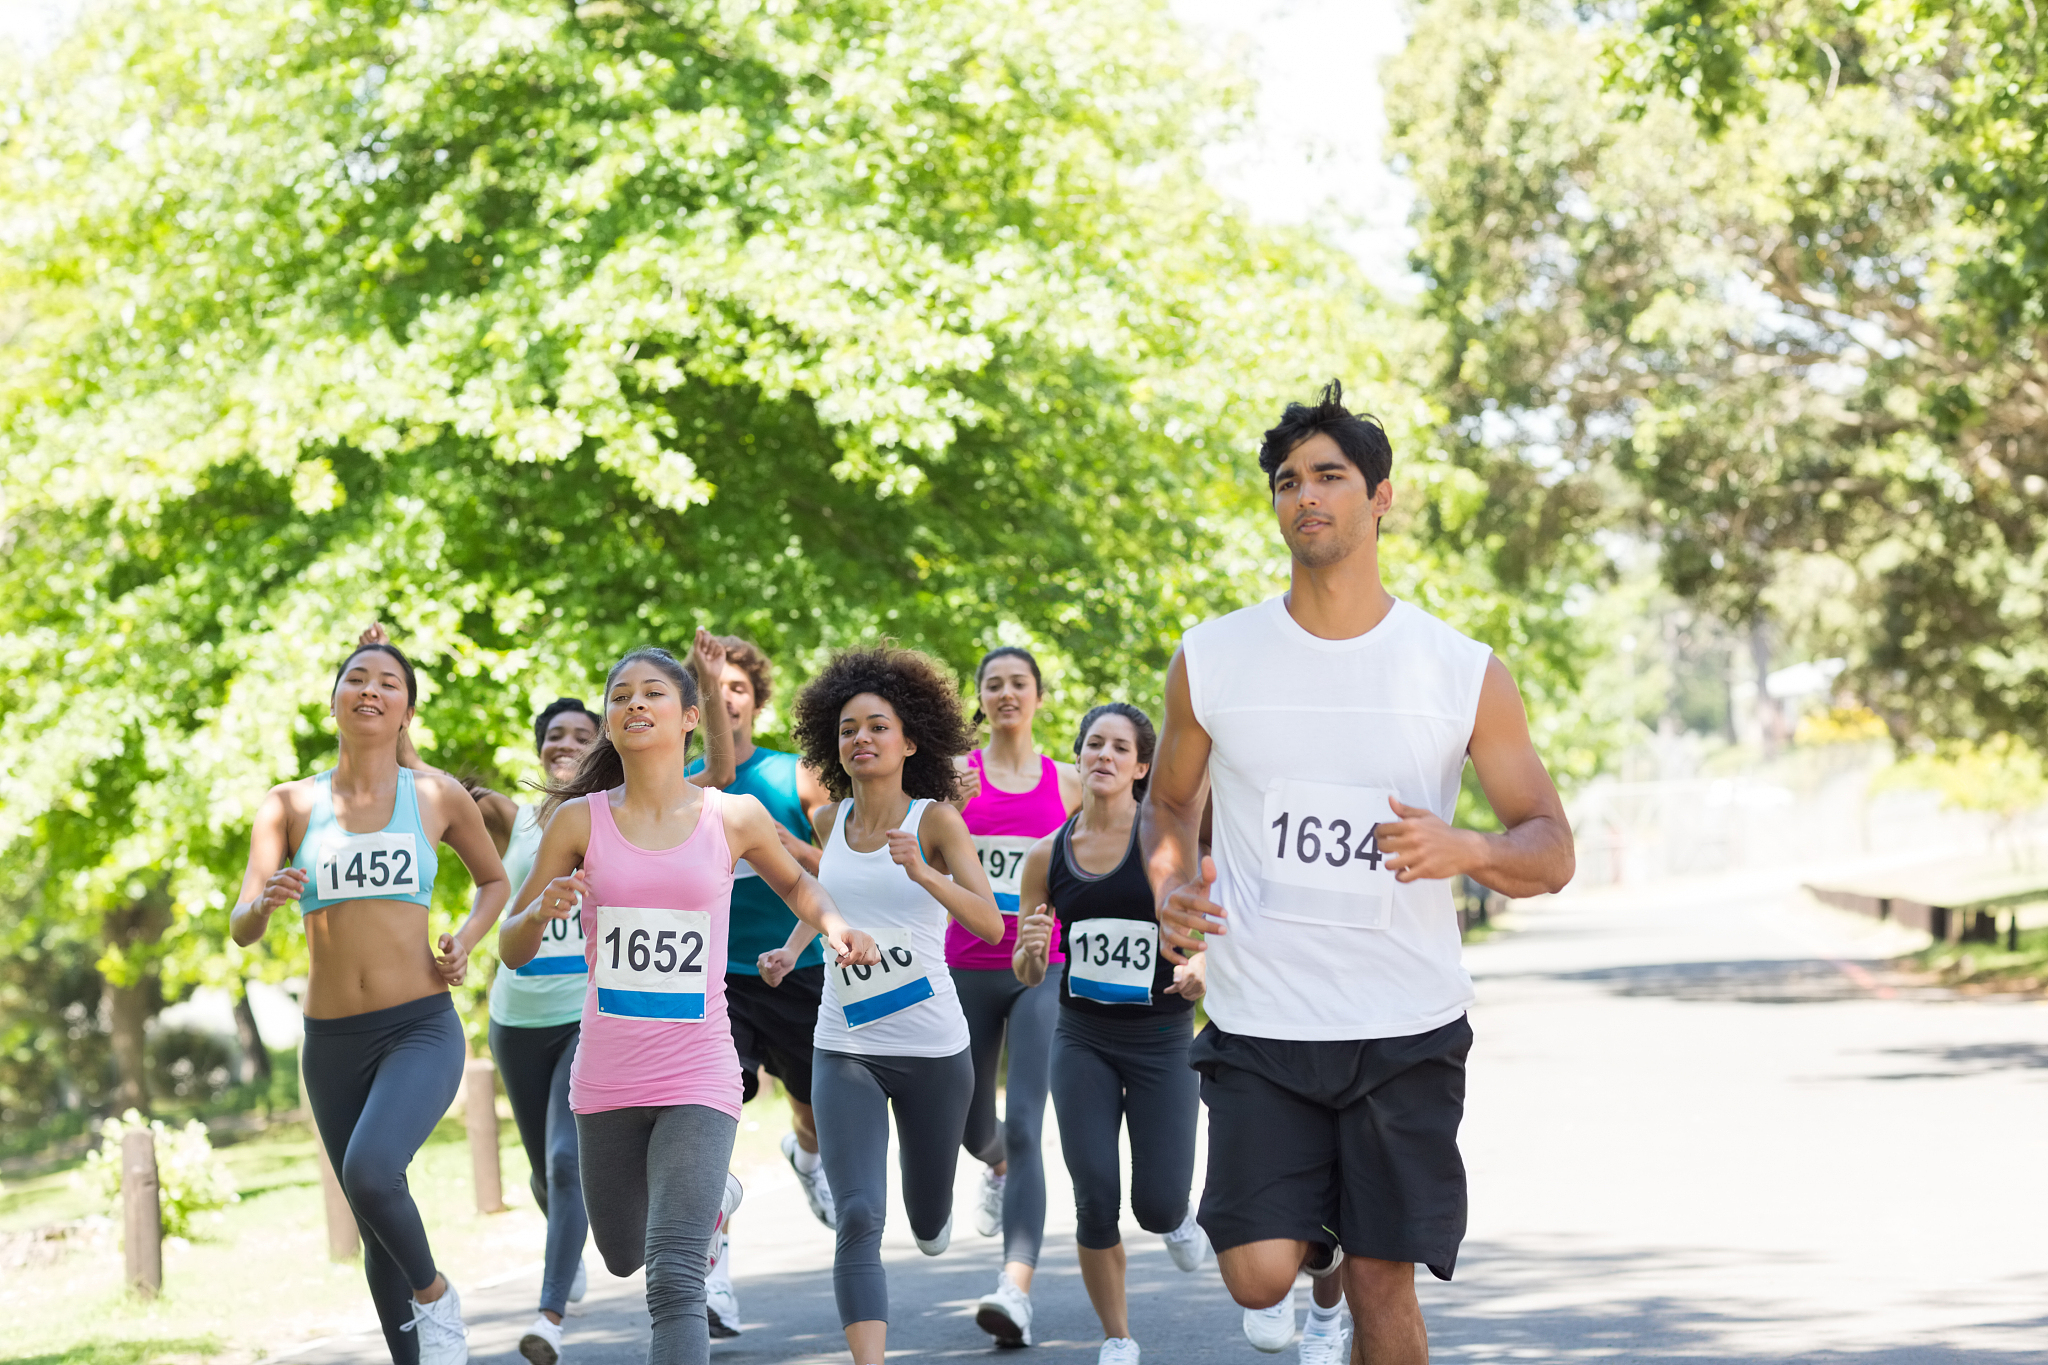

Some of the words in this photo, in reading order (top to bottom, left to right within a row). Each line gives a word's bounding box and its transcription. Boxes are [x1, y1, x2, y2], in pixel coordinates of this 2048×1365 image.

[1271, 812, 1382, 871] 1634
[323, 849, 413, 890] 1452
[541, 909, 583, 941] 01
[605, 927, 704, 973] 1652
[1076, 932, 1150, 971] 1343
